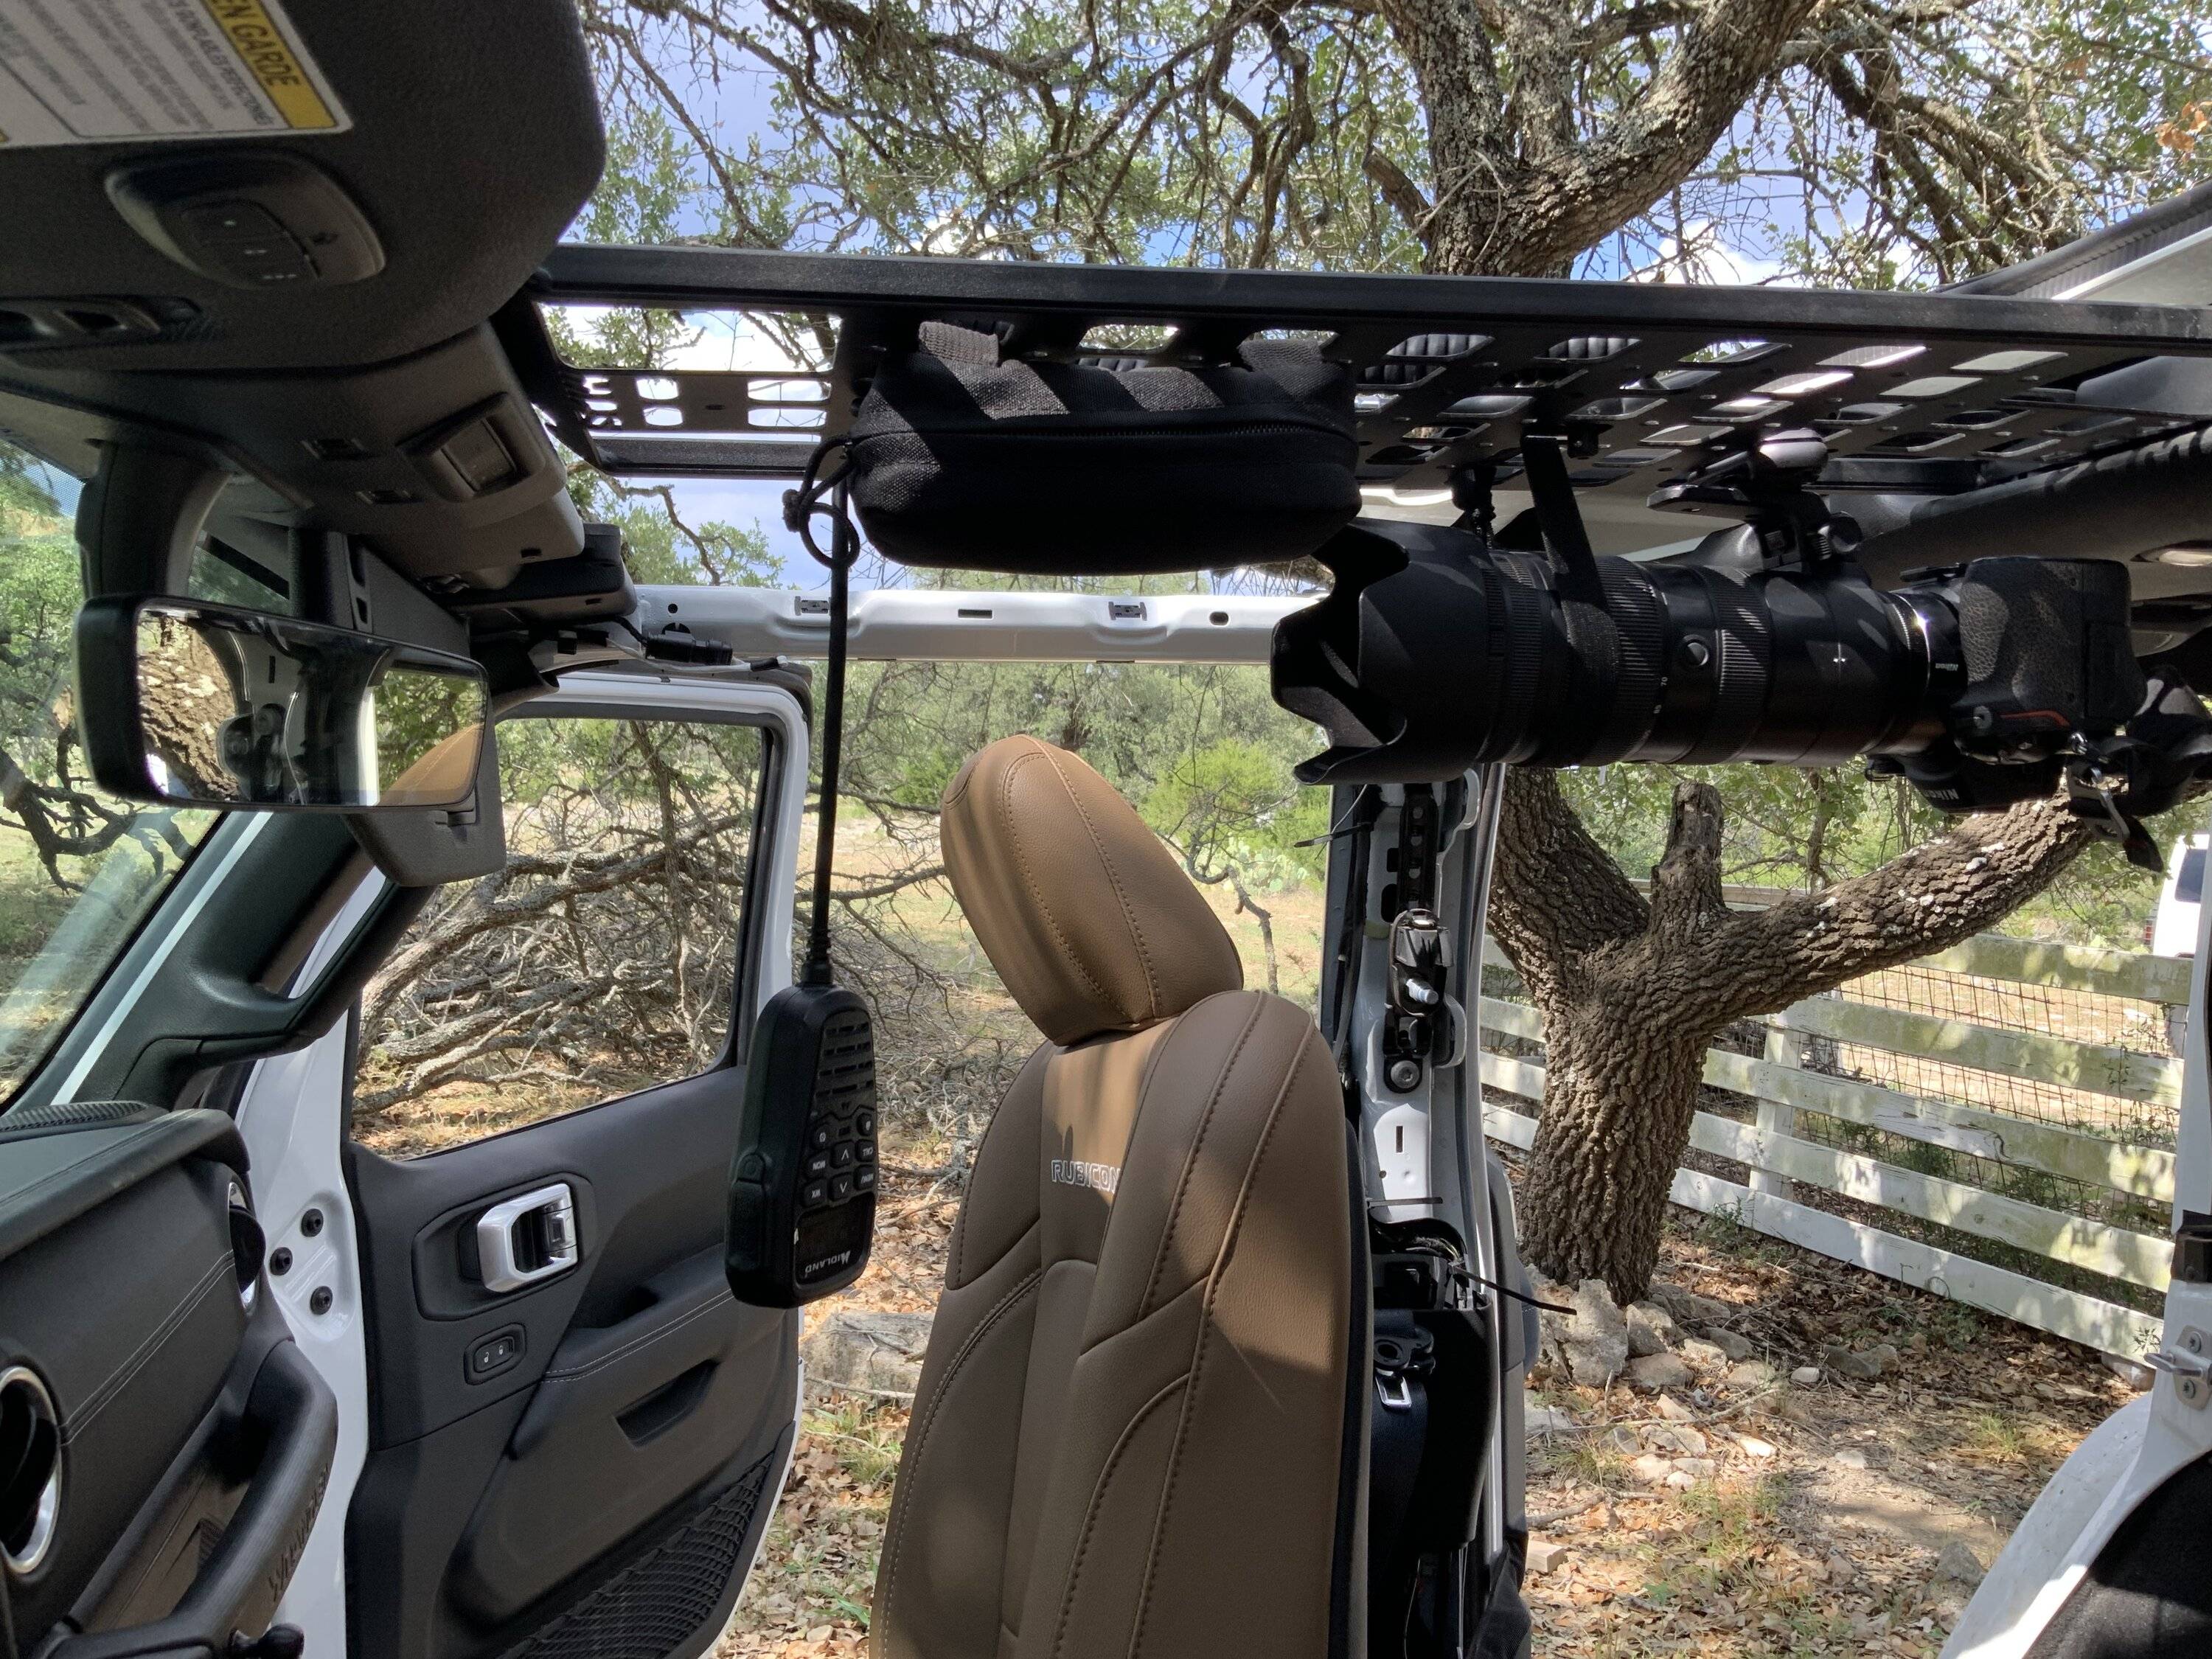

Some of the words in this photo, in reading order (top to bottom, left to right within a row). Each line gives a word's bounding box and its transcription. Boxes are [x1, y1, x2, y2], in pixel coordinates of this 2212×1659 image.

[231, 24, 300, 86] GARDE
[1051, 1160, 1121, 1194] RUBICON
[804, 1251, 851, 1279] MIDLAND
